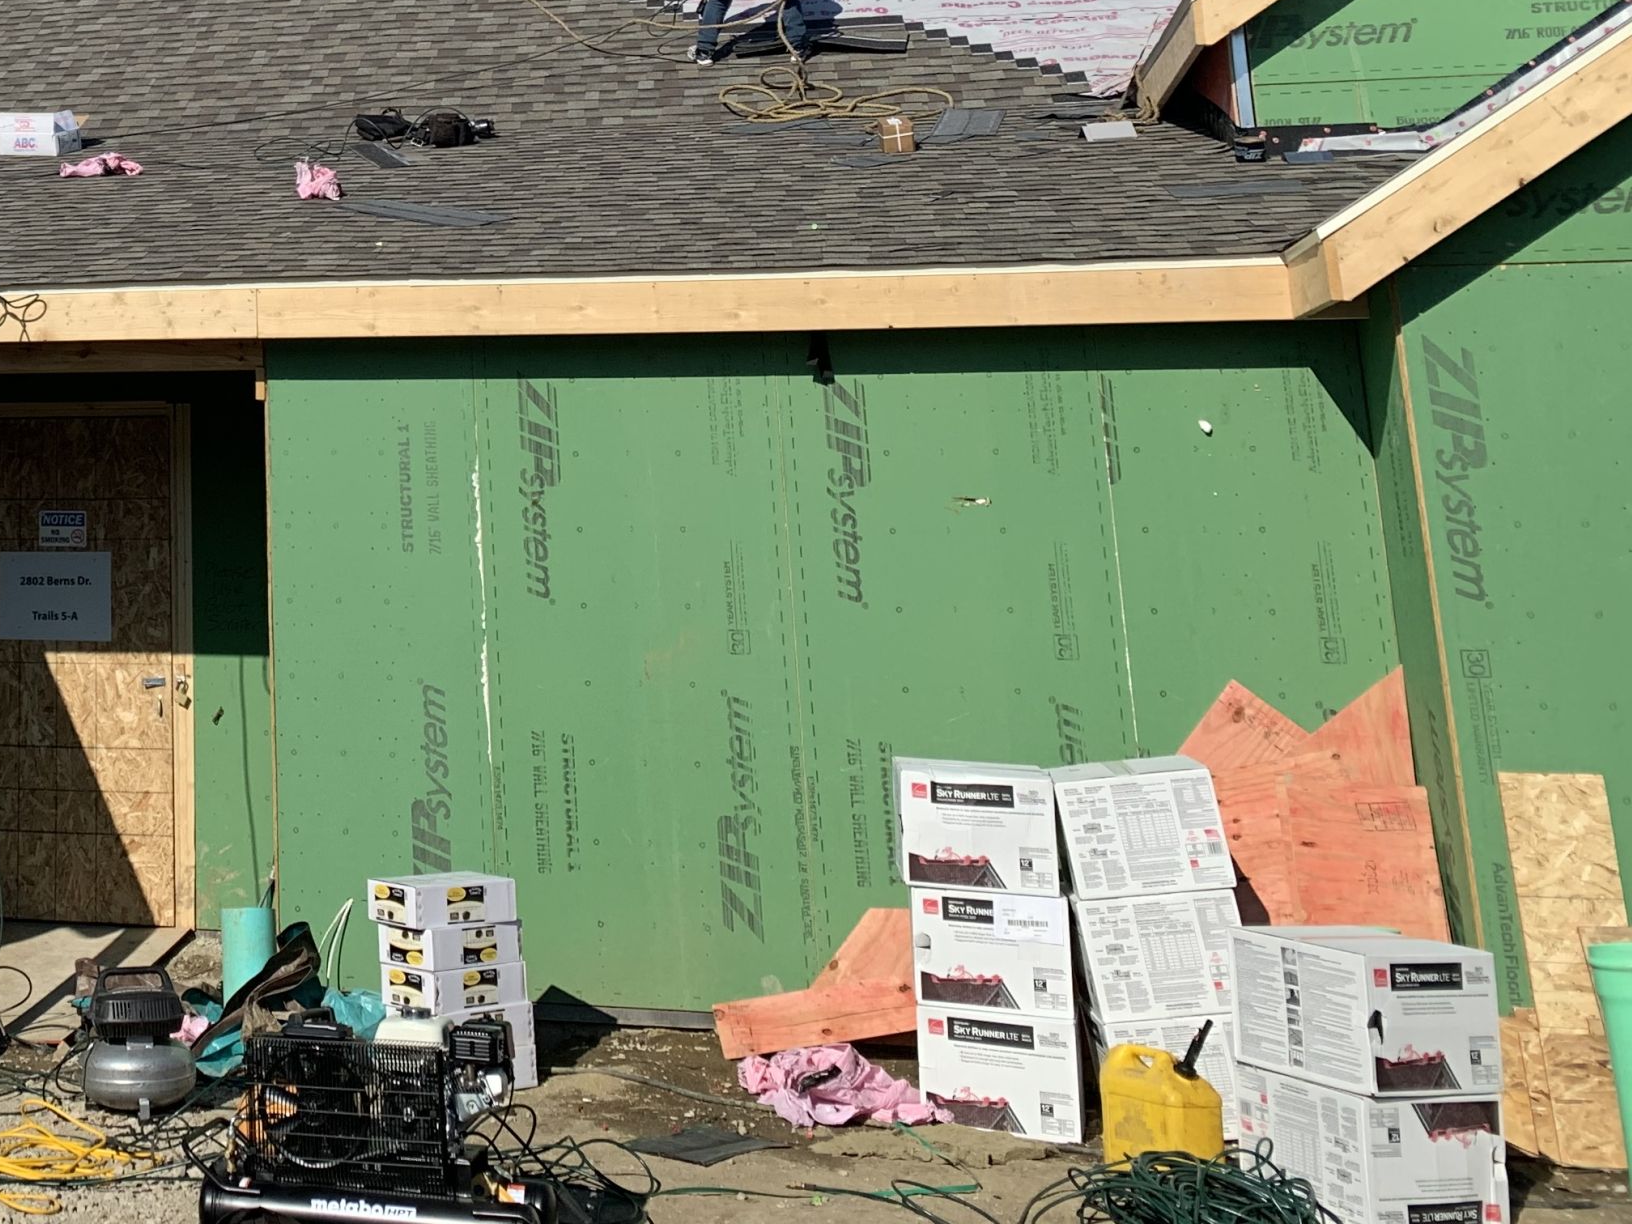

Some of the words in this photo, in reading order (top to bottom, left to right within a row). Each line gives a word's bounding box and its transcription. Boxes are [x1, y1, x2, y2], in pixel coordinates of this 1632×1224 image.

[1531, 0, 1618, 14] STRUCTU
[424, 421, 440, 487] SHEATHING
[398, 437, 414, 553] STRUCTURAL
[43, 514, 83, 525] NOTICE
[41, 536, 70, 544] SMOKING
[19, 576, 45, 586] 2802
[47, 576, 75, 586] Berns
[78, 576, 92, 586] Dr.
[32, 611, 59, 621] Trails
[61, 611, 78, 621] 5-A
[1466, 652, 1486, 676] 30
[936, 788, 953, 798] SKY
[954, 789, 986, 800] RUNNER
[948, 904, 965, 914] SKY
[966, 906, 993, 916] RUNNE
[1395, 973, 1410, 982] SKY
[954, 1025, 971, 1035] SKY
[972, 1027, 1005, 1039] RUNNER
[311, 1198, 383, 1216] metabo
[386, 1208, 414, 1217] HPT
